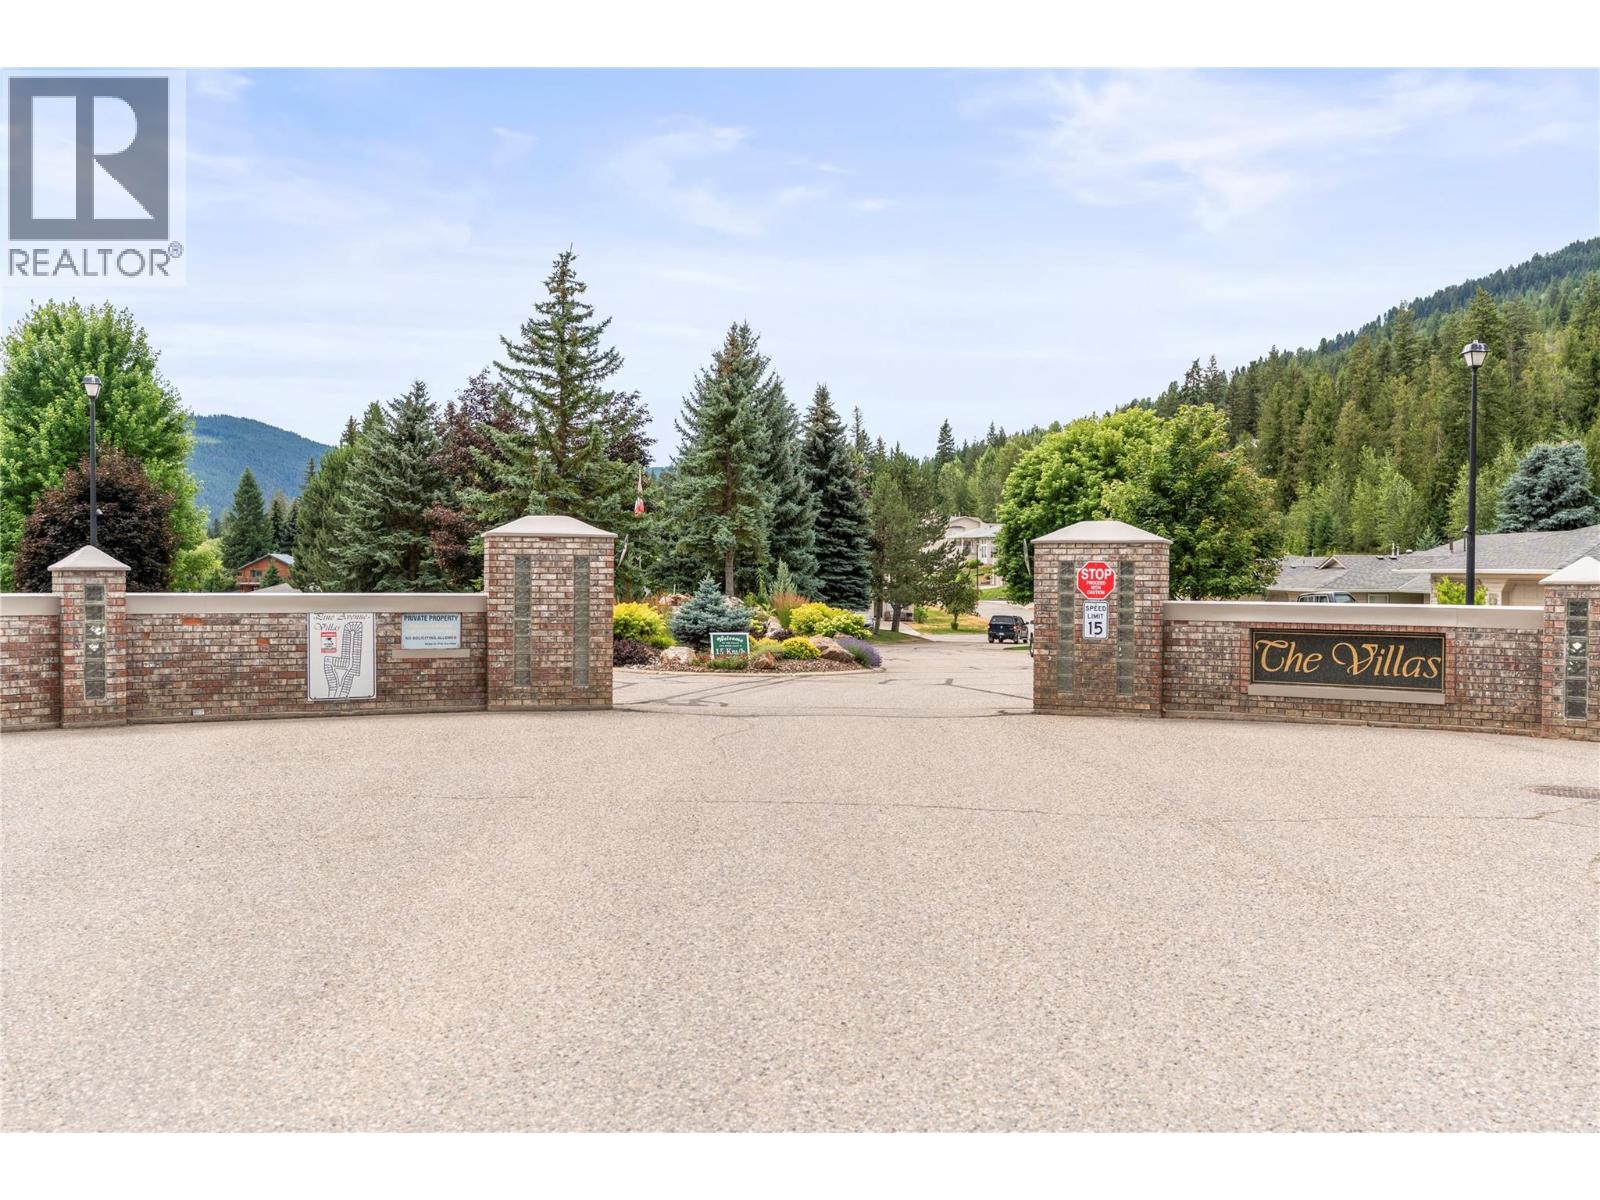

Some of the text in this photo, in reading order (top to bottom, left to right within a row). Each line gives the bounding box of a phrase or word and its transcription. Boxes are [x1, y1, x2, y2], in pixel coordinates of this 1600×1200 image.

[1081, 568, 1112, 580] STOP
[403, 614, 459, 622] PRIVATE PROPERTY
[1088, 621, 1104, 635] 15
[1255, 639, 1441, 679] The Villas
